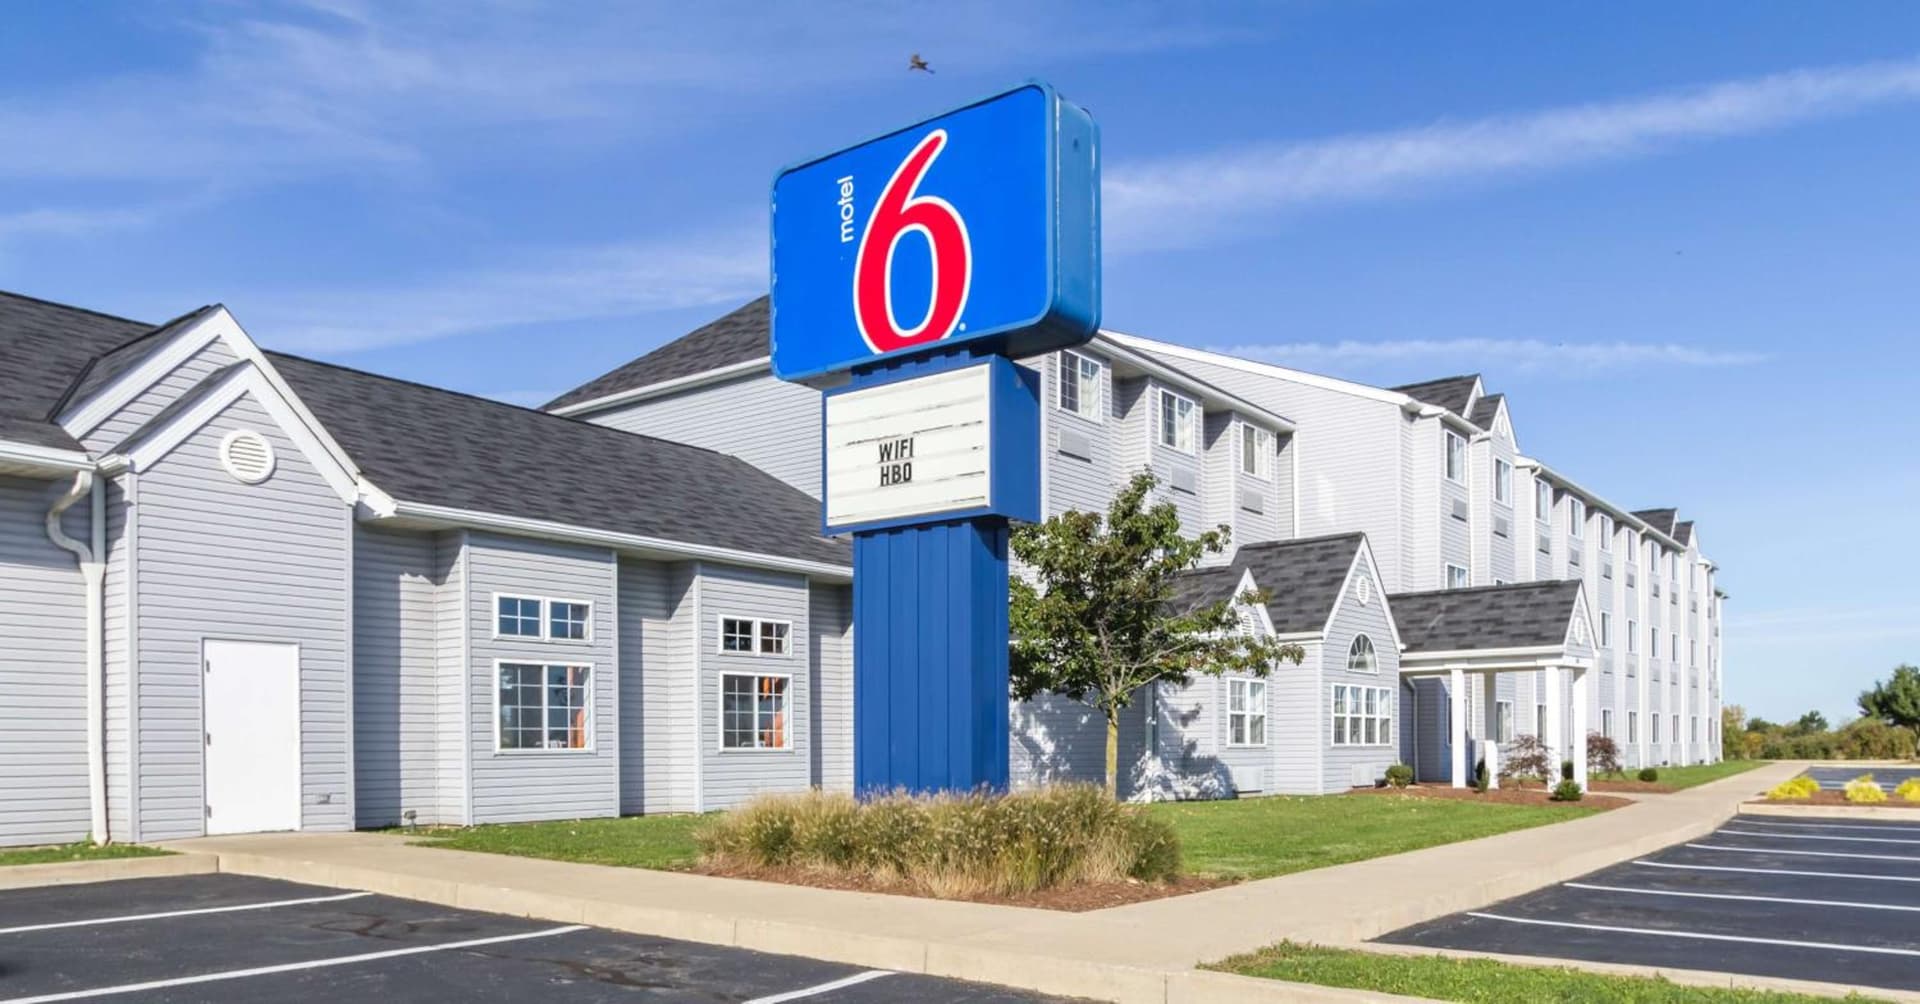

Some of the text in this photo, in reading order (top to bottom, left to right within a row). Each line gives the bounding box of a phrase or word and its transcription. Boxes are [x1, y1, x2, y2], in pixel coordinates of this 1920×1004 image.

[837, 175, 854, 243] motel
[853, 129, 972, 354] 6
[878, 437, 914, 462] WIFI
[880, 462, 912, 487] HBO
